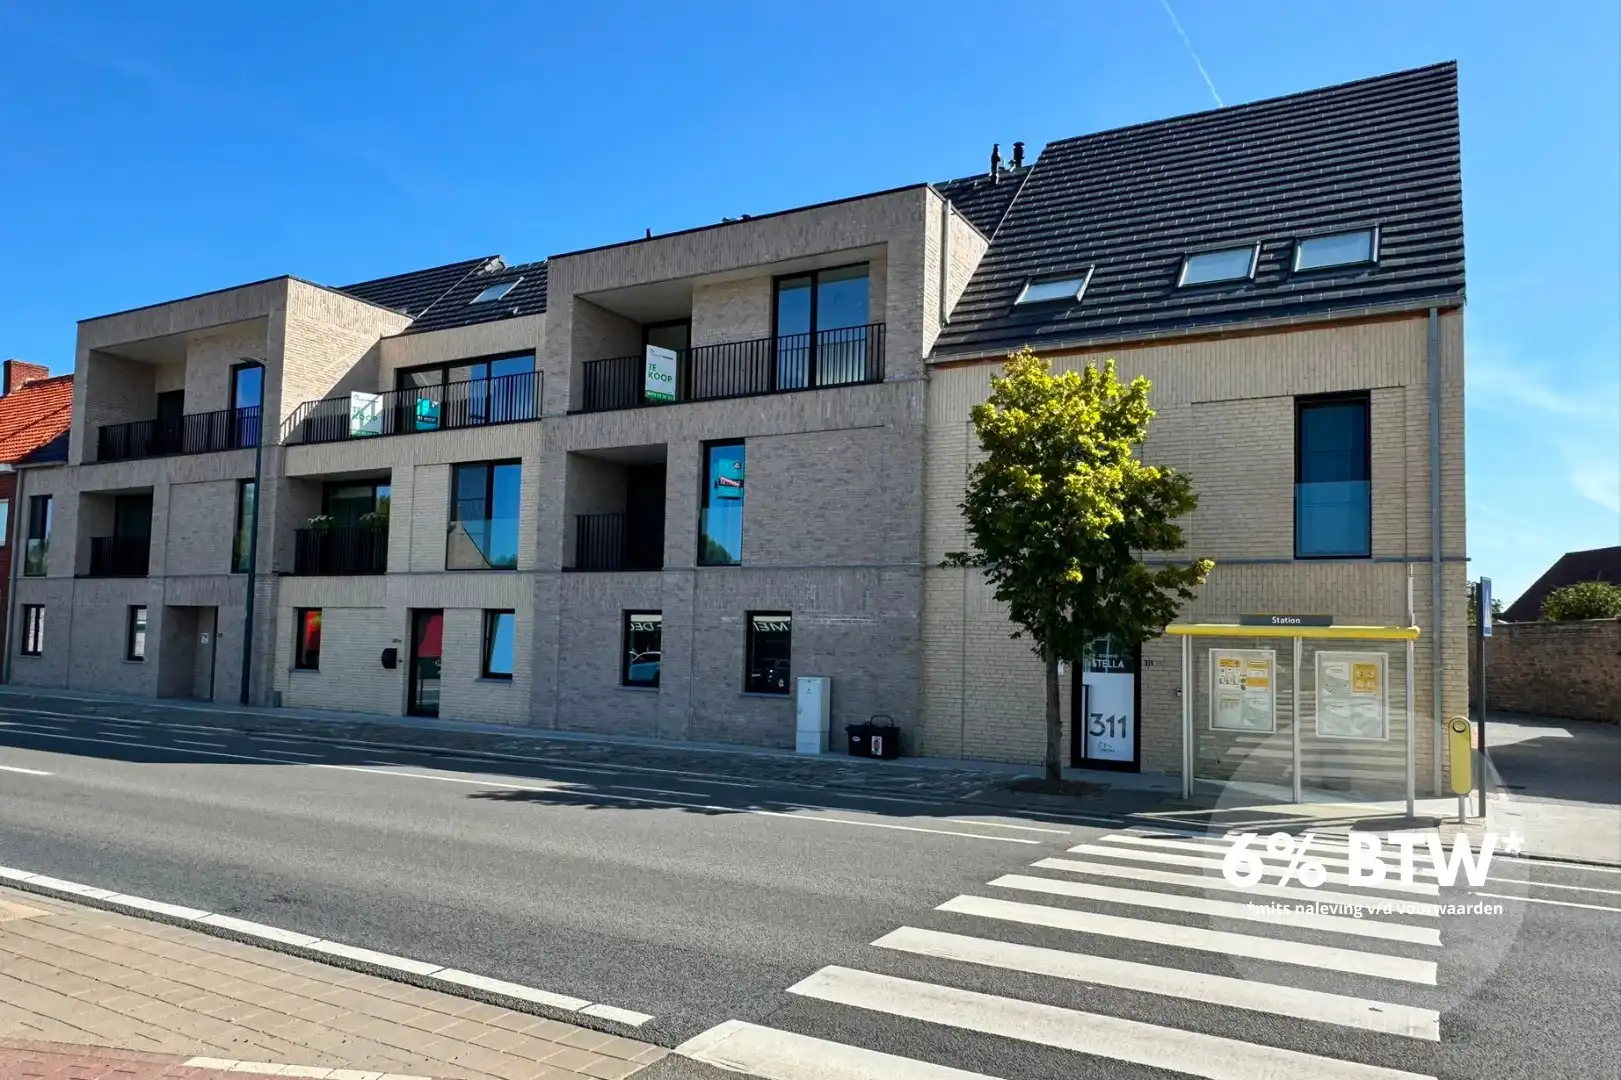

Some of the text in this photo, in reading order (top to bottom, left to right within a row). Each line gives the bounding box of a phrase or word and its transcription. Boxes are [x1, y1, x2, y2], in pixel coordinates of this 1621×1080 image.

[648, 363, 657, 371] TE
[648, 371, 673, 382] KOOP
[1271, 615, 1301, 624] Station
[1092, 659, 1124, 668] STELLA
[1089, 713, 1126, 738] 311
